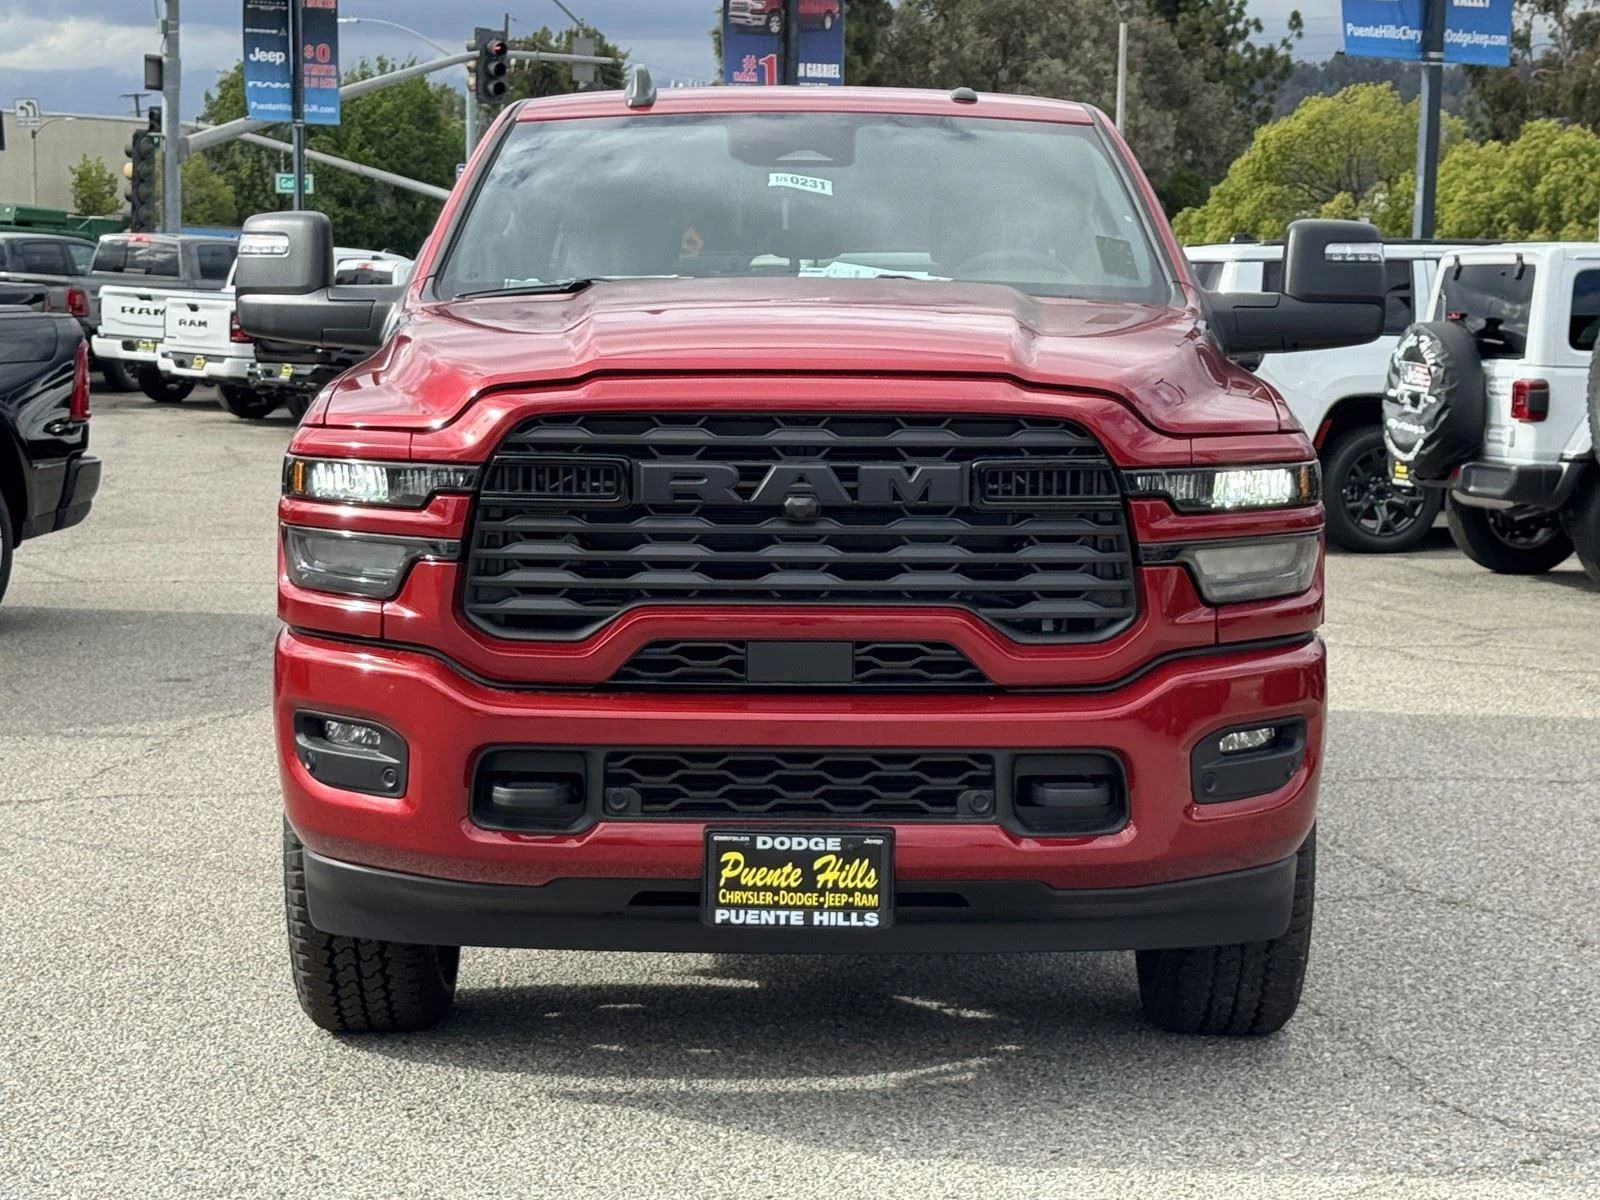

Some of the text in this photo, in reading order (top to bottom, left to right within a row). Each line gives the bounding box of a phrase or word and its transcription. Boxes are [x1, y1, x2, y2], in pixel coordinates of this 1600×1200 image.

[249, 47, 286, 66] Jeep
[790, 176, 827, 191] 0231
[178, 318, 208, 328] RAM
[639, 461, 967, 504] RAM
[756, 836, 842, 851] DODGE
[719, 851, 879, 889] Puente Hills
[715, 909, 880, 926] PUENTE HILLS
